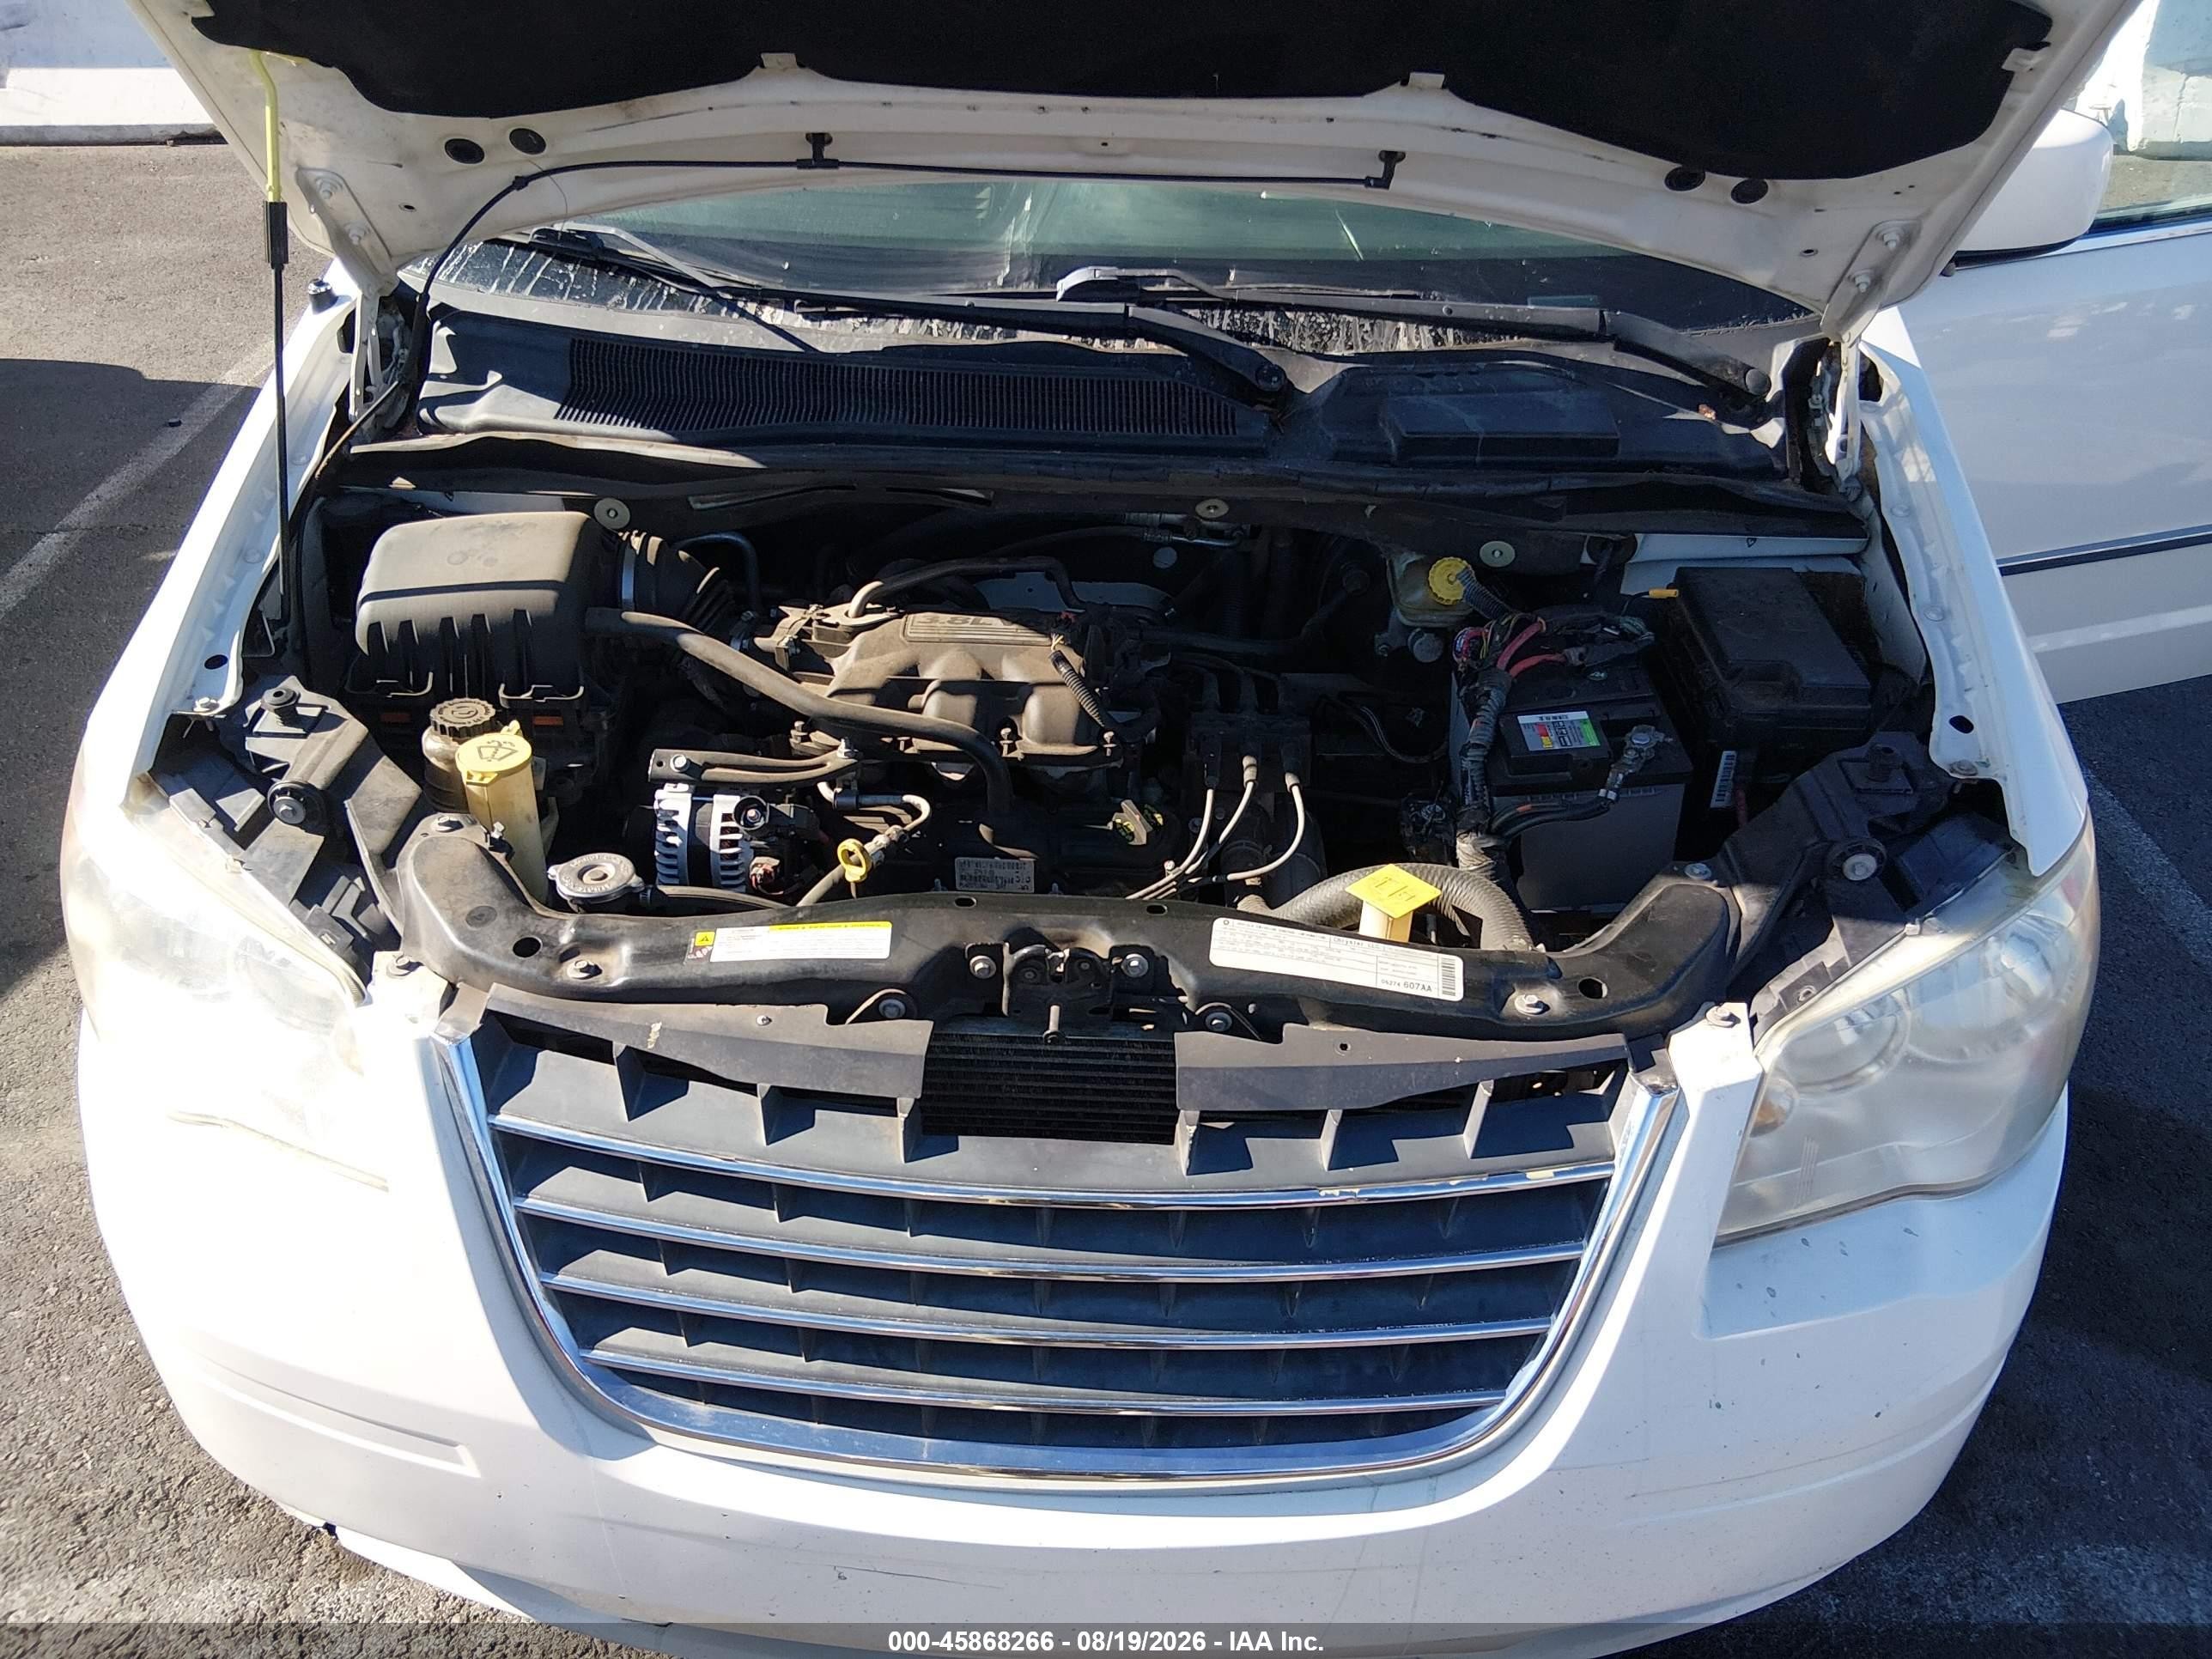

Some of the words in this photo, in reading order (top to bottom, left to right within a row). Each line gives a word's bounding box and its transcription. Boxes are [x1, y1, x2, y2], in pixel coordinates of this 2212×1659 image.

[917, 615, 993, 626] 3.8L
[1333, 937, 1364, 947] Chrysler
[1403, 981, 1433, 993] 607AA
